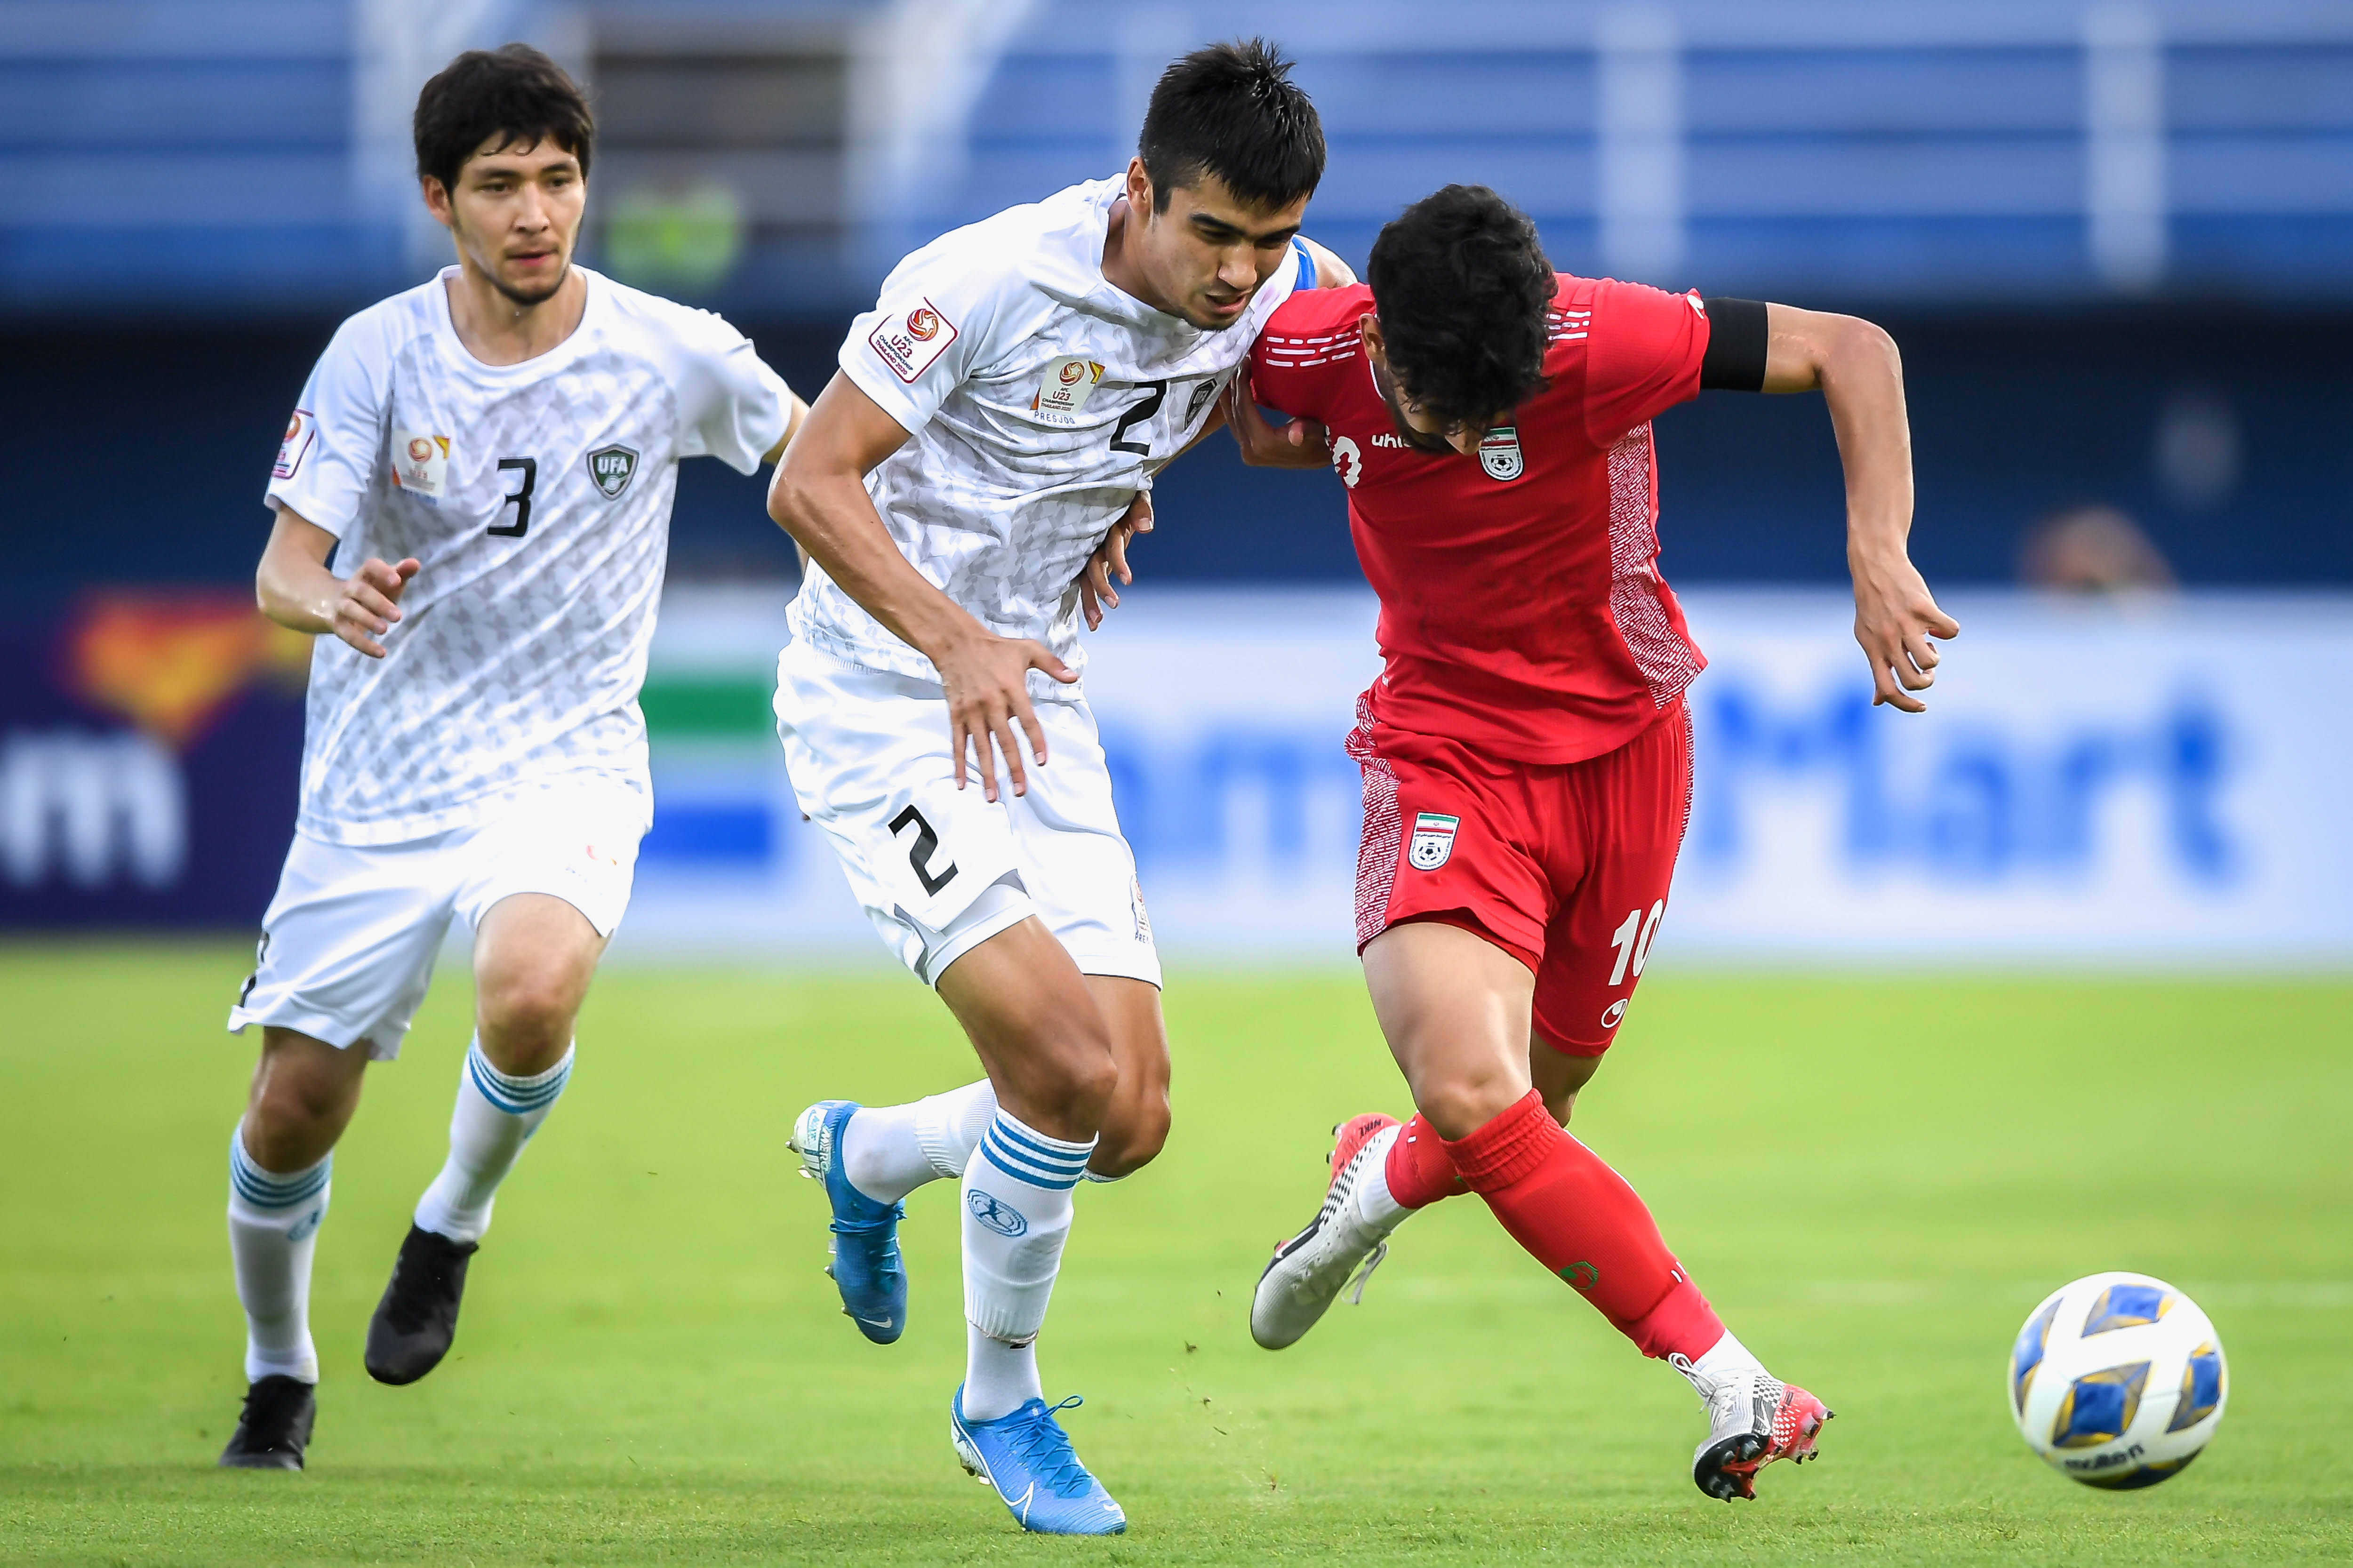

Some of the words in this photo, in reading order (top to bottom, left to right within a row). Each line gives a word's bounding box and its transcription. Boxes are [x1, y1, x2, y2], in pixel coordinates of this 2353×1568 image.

[875, 339, 896, 364] THAILAND
[895, 362, 908, 376] 2020
[879, 335, 913, 371] CHAMPIONSHIP
[891, 334, 913, 359] U23
[903, 336, 913, 346] AFC
[1042, 398, 1074, 407] CHAMPIONSHIP
[1052, 391, 1071, 401] U23
[1109, 379, 1167, 457] 2
[597, 456, 629, 474] UFA
[487, 458, 536, 537] 3
[888, 804, 959, 897] 2
[1608, 898, 1664, 986] 10
